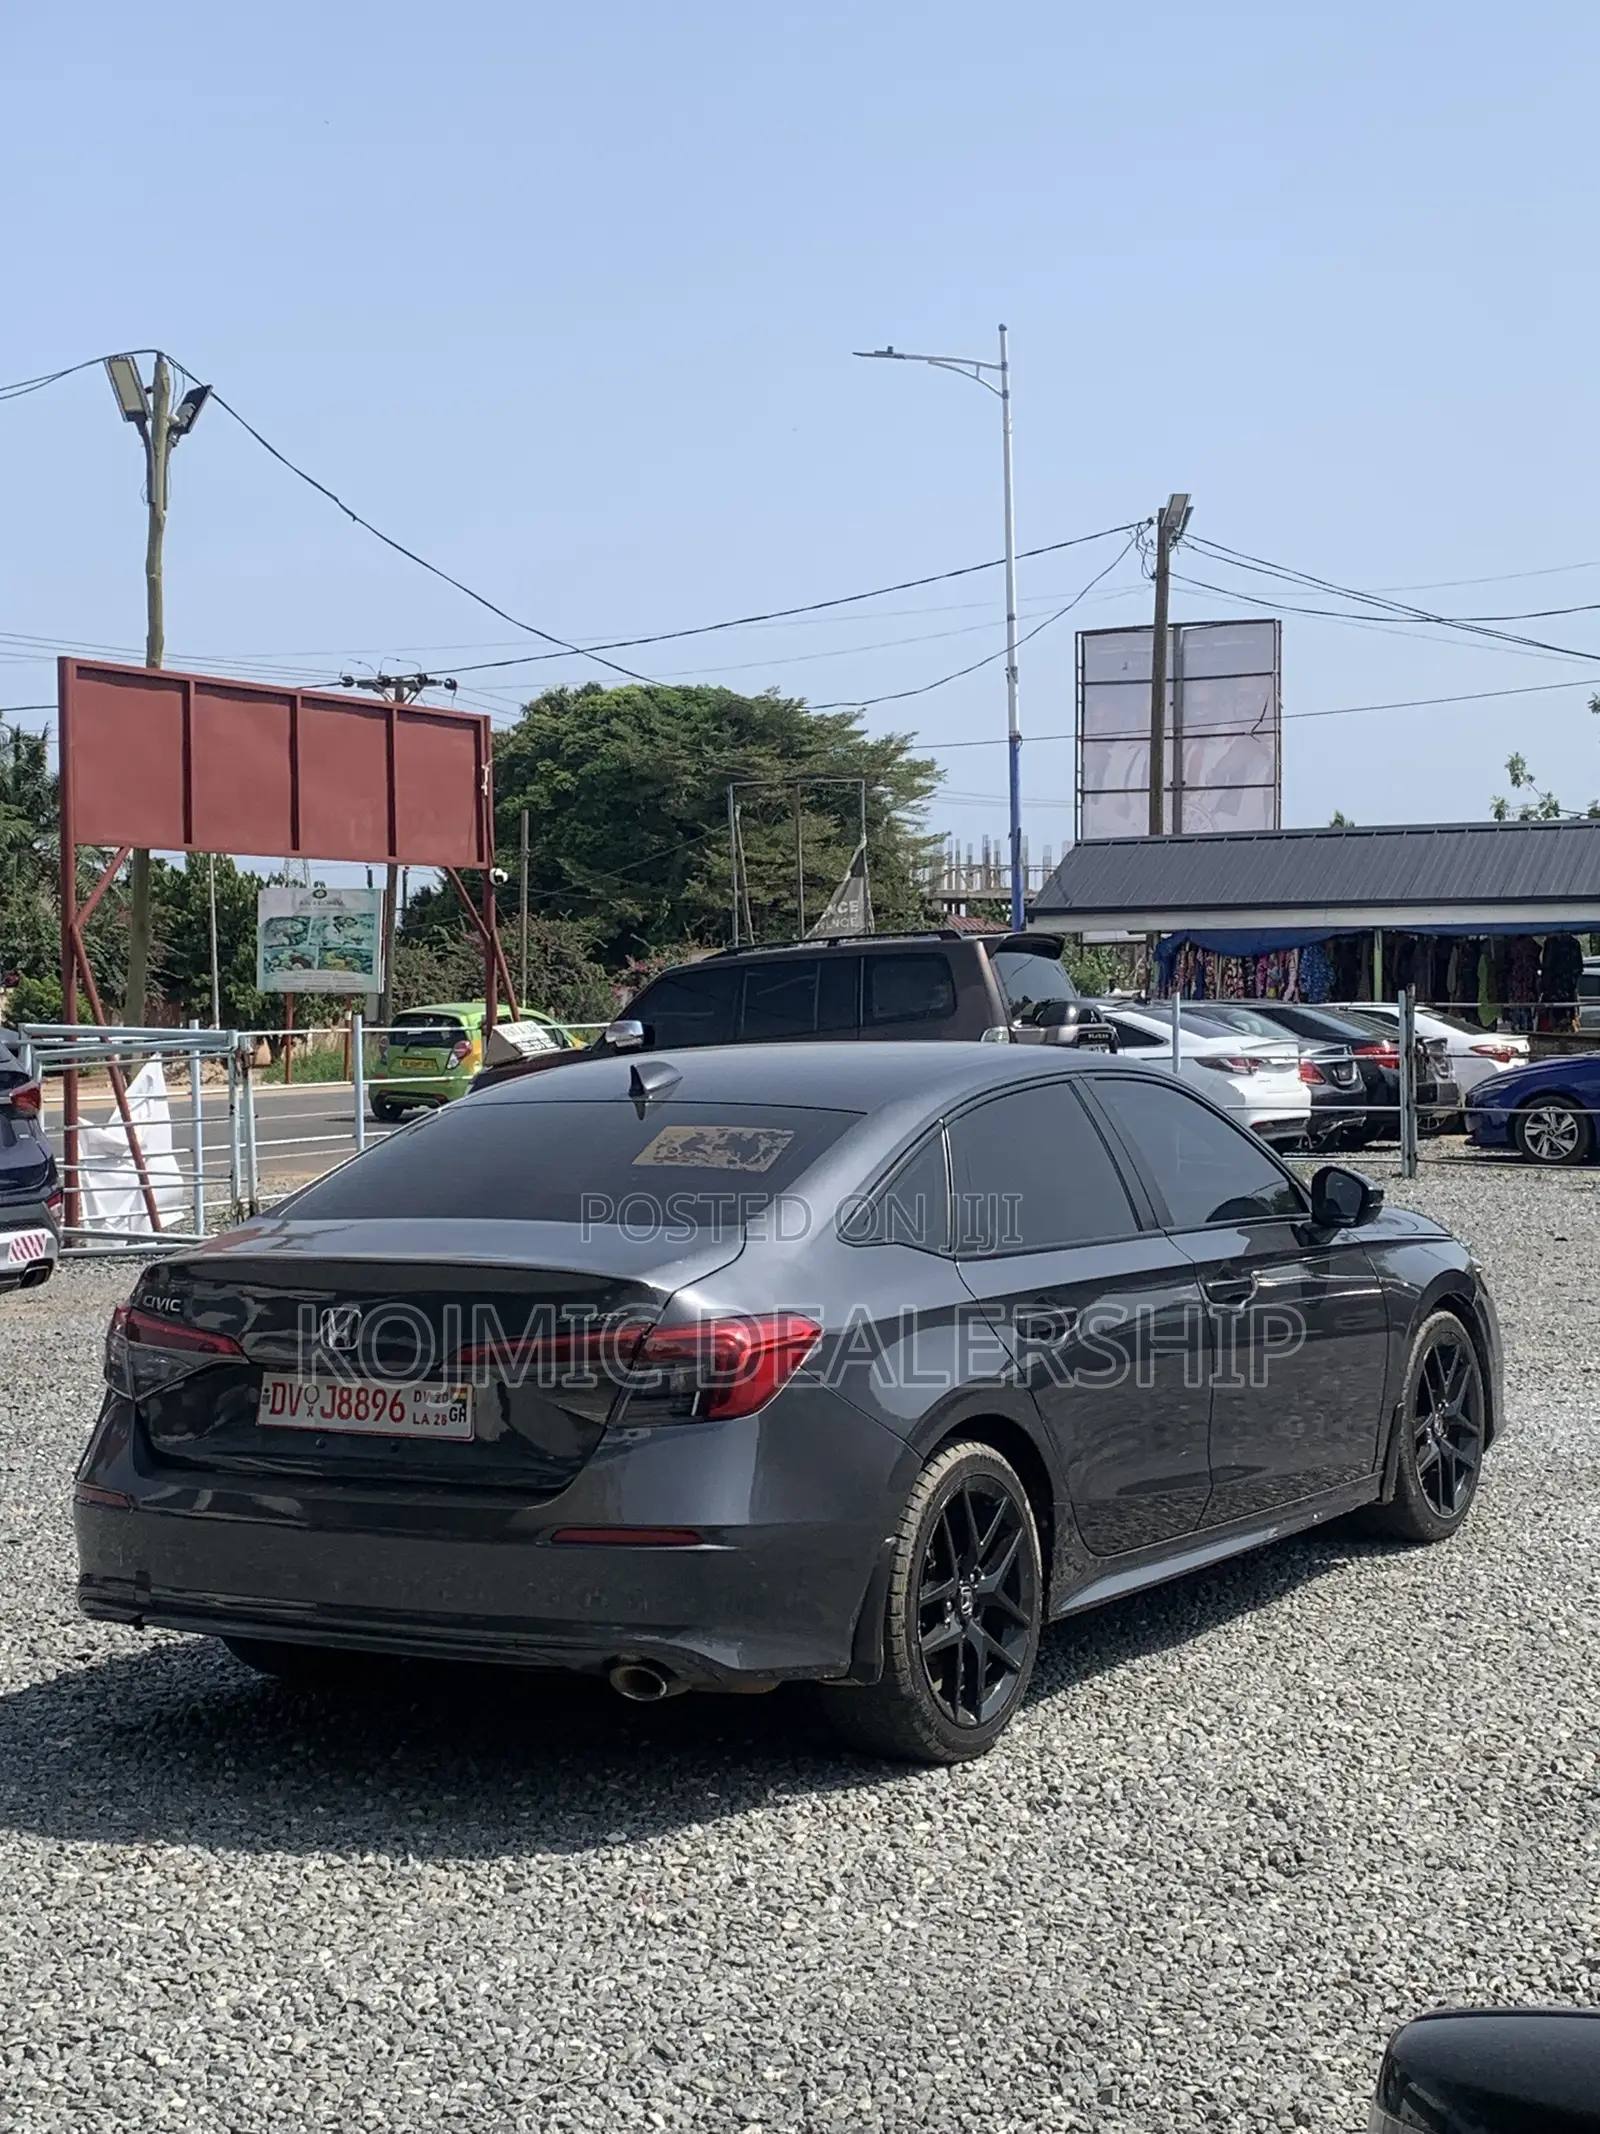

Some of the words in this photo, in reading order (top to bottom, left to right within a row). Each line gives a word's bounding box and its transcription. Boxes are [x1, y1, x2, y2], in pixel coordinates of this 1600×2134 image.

[142, 1295, 182, 1312] CIVIC
[269, 1382, 303, 1416] DV
[320, 1384, 406, 1424] J8896
[412, 1412, 430, 1425] LA
[449, 1406, 467, 1423] GH
